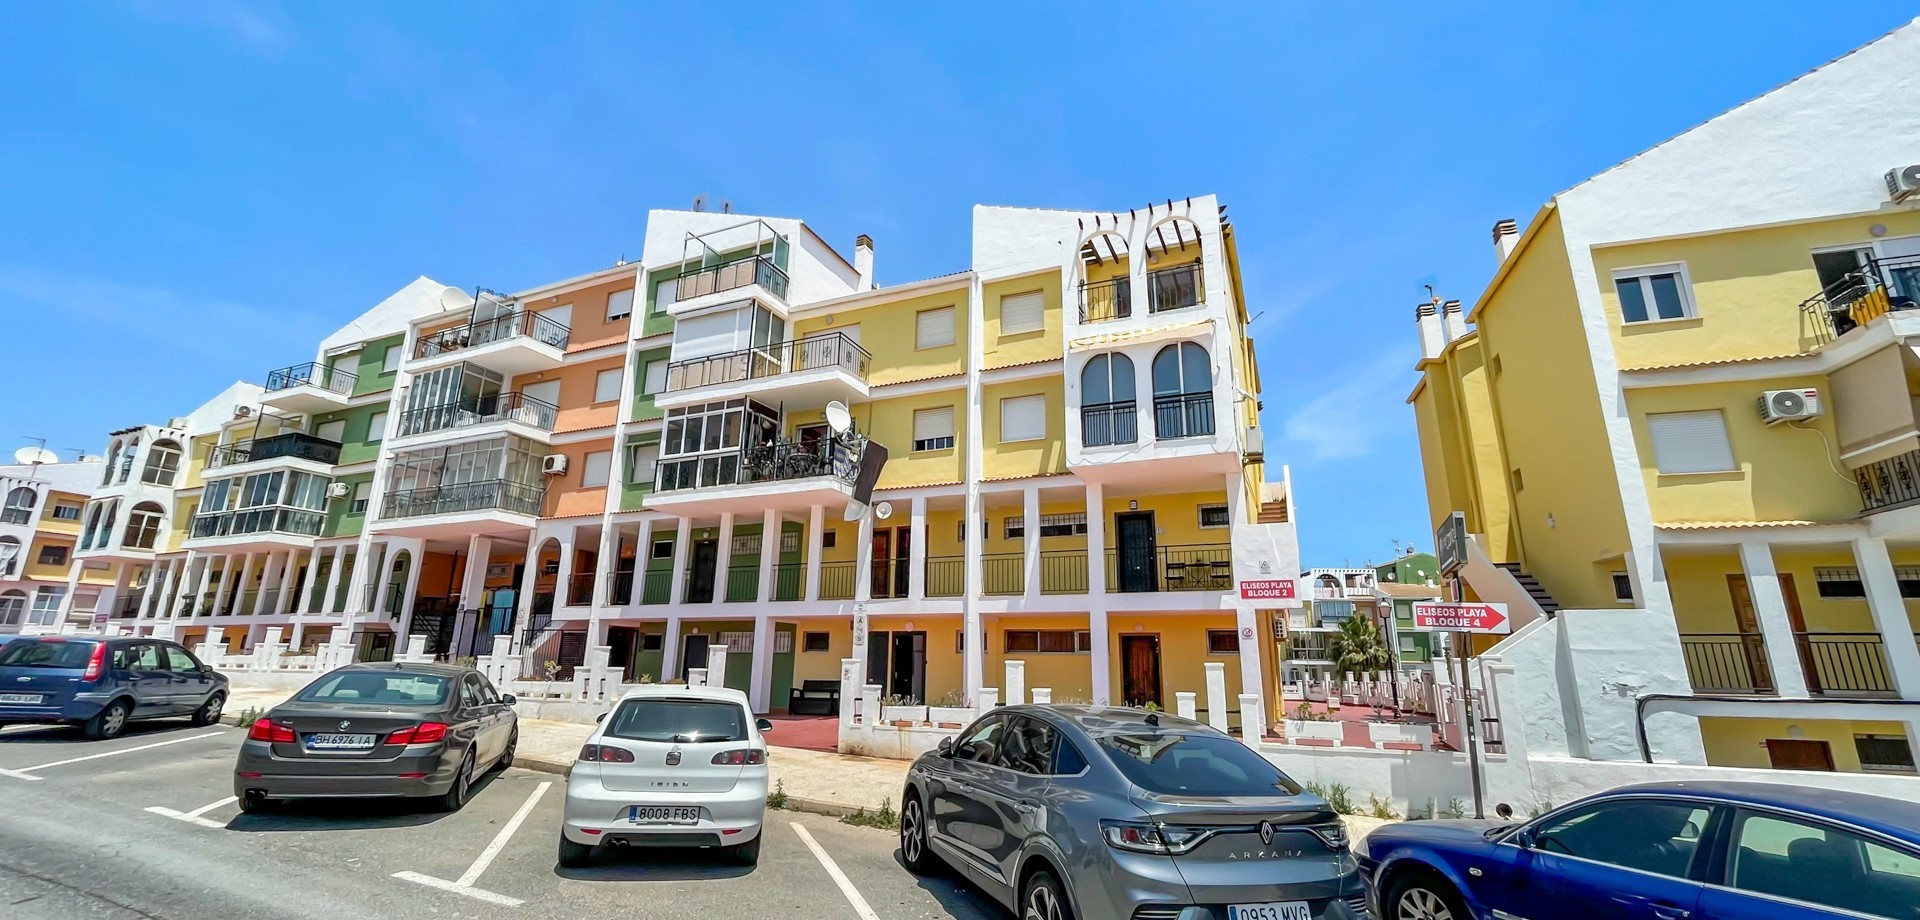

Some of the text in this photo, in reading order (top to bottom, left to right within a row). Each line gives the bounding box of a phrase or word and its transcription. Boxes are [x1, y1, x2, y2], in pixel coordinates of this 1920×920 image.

[1270, 581, 1293, 589] PLAYA
[1247, 589, 1281, 597] BLOQUE
[1417, 607, 1488, 618] ELISEOS PLAYA
[1425, 617, 1481, 627] BLOQUE 4
[315, 735, 331, 745] BH
[332, 735, 354, 745] 6976
[639, 808, 697, 820] 8008 FBS
[1228, 850, 1303, 859] ARKANA
[1240, 905, 1309, 920] 0953 MVG
